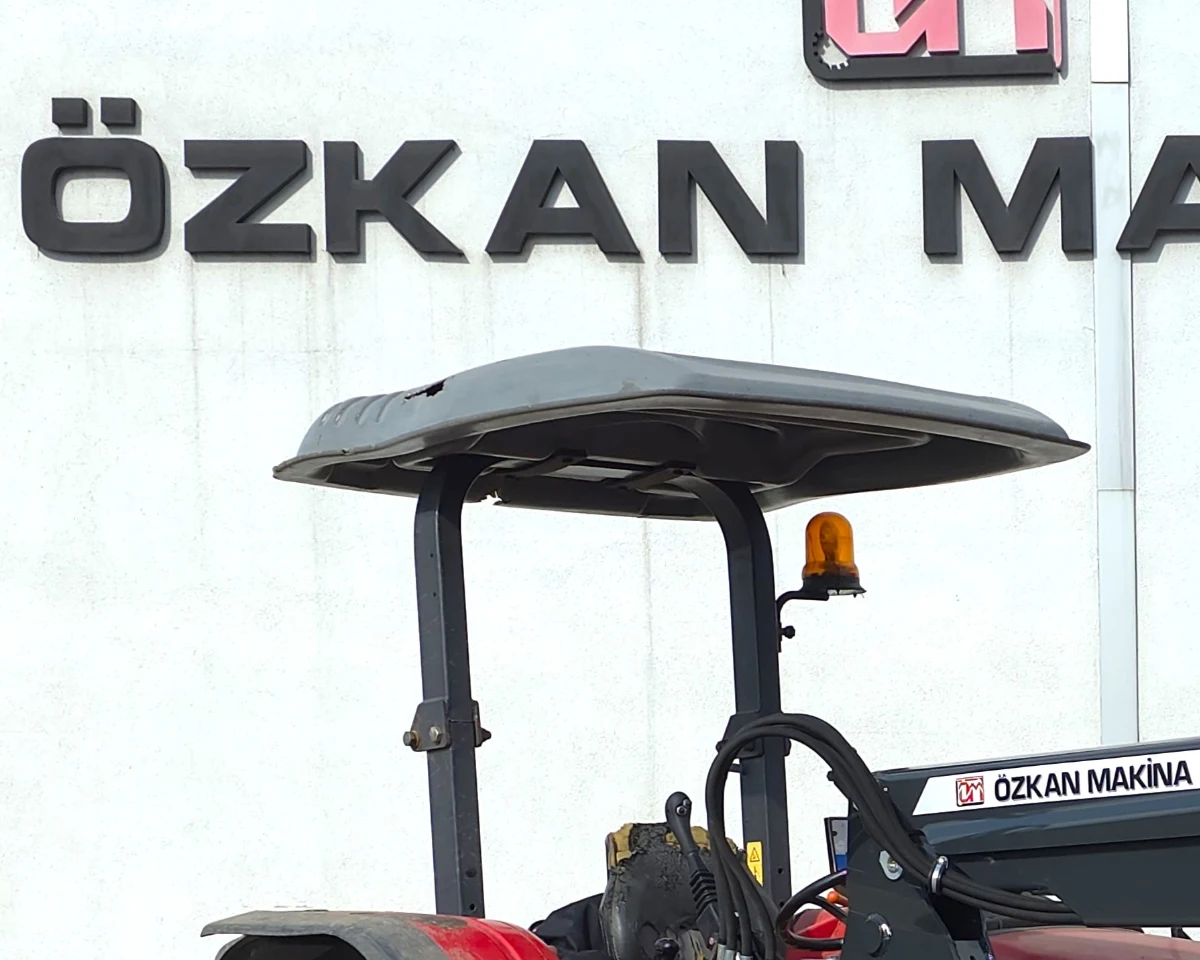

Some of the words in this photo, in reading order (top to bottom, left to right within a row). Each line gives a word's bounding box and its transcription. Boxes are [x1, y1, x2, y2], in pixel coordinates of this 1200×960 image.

[20, 96, 802, 257] ÖZKAN
[993, 773, 1081, 802] ÖZKAN
[1087, 757, 1193, 796] MAKİNA
